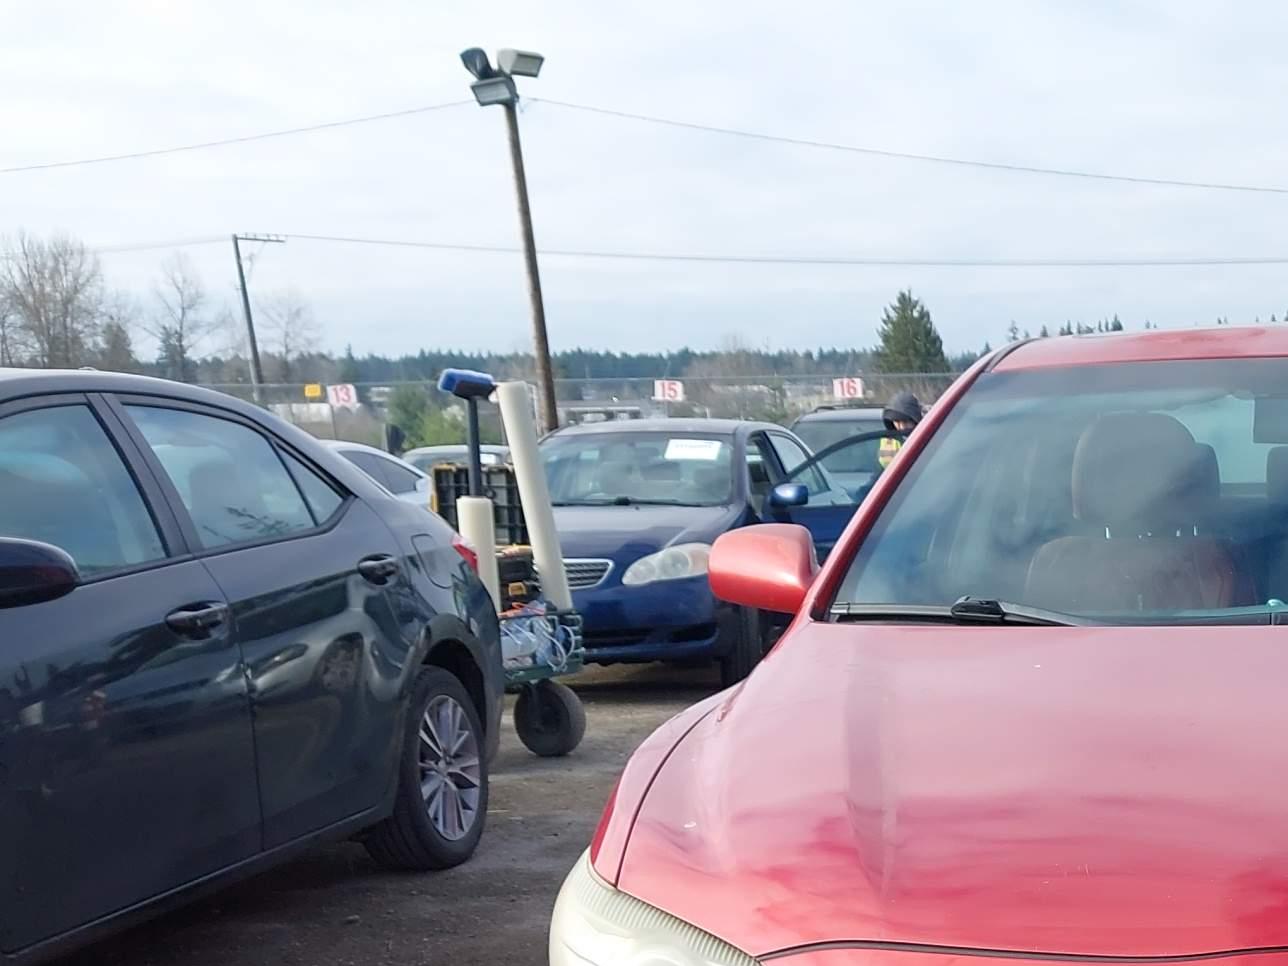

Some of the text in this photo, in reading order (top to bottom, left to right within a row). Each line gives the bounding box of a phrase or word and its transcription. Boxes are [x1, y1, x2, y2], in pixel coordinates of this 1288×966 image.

[332, 384, 351, 403] 13
[660, 382, 678, 399] 15
[840, 379, 857, 397] 16
